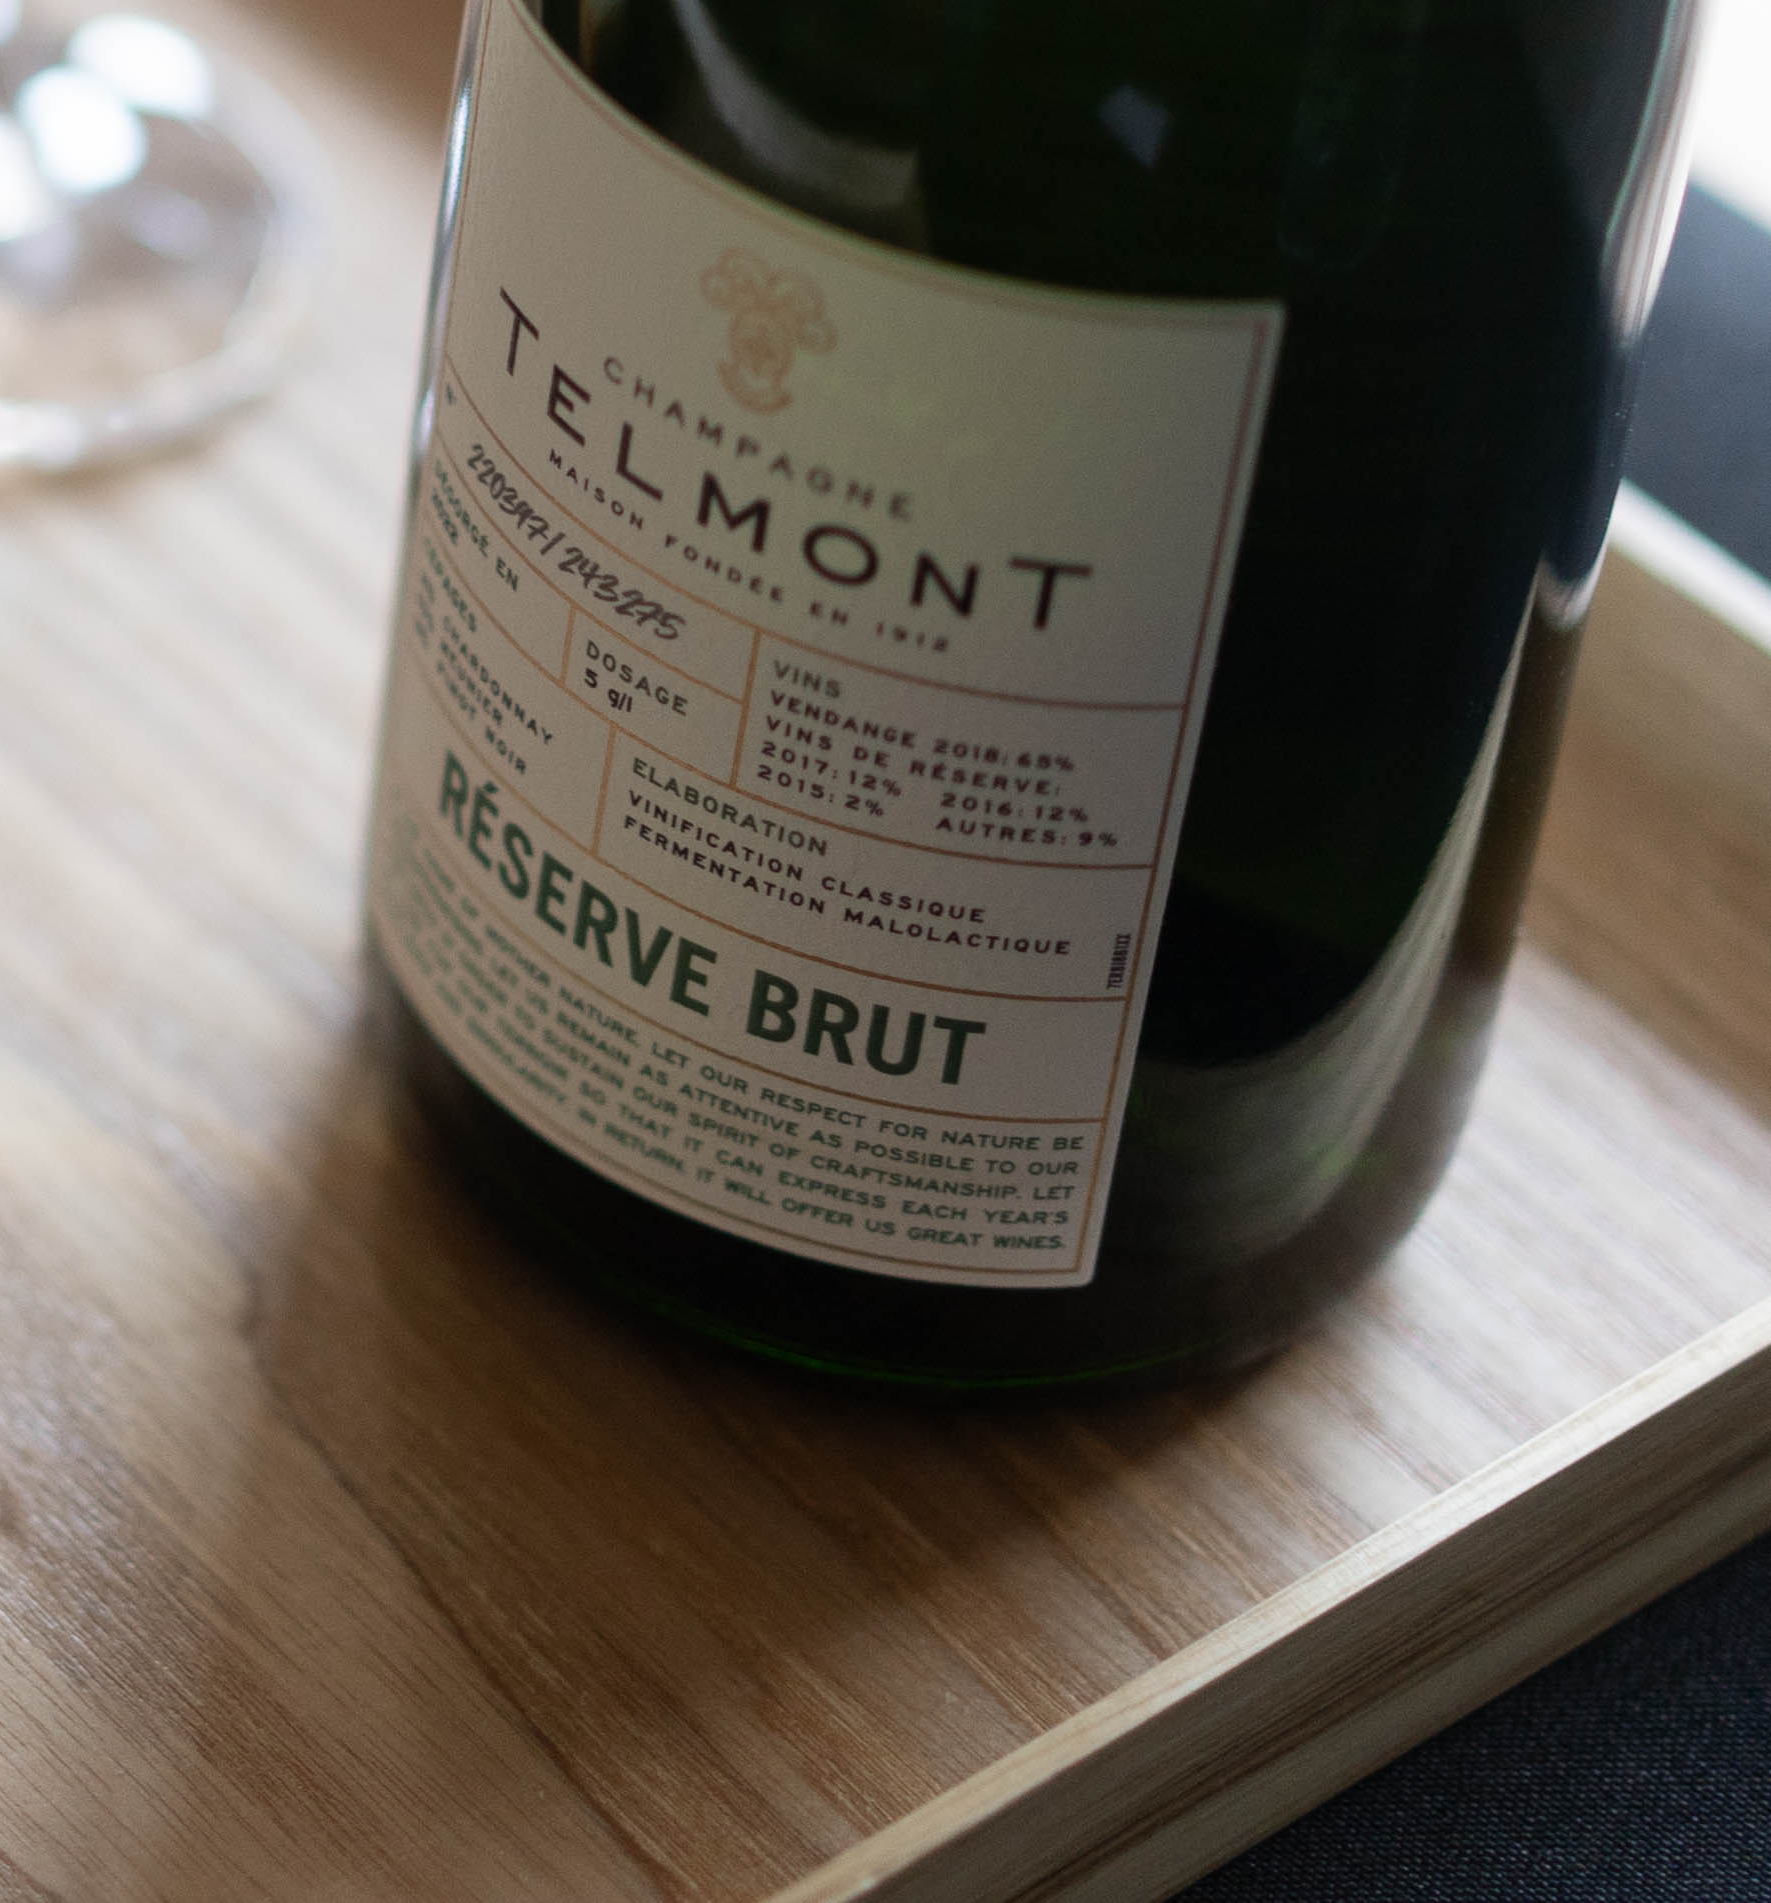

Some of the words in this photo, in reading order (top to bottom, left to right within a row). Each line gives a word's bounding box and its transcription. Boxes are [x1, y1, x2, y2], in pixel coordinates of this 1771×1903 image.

[499, 286, 1093, 631] TELMONT
[603, 355, 911, 521] CHAMPAGNE
[496, 556, 520, 592] EN
[548, 449, 645, 530] MAISON
[808, 599, 849, 626] EN
[583, 667, 599, 689] 5
[607, 688, 633, 713] g/l
[585, 639, 689, 717] DOSAGE
[770, 690, 917, 748] VENDANGE
[772, 659, 843, 699] VINS
[485, 726, 527, 775] NOIR
[765, 714, 833, 750] VINS
[852, 744, 891, 768] DE
[631, 756, 828, 857] ELABORATION
[844, 794, 884, 818] 2%
[936, 817, 1068, 846] AUTRES:
[848, 768, 902, 797] 12%
[1034, 805, 1089, 824] 12%
[623, 815, 826, 914] FERMENTATION
[843, 907, 1071, 956] MALOLACTIQUE
[628, 790, 804, 882] VINIFICATION
[820, 875, 986, 924] CLASSIQUE
[439, 748, 718, 1017] RÉSERVE
[746, 968, 987, 1085] BRUT
[557, 1010, 631, 1067] REMAIN
[639, 1063, 670, 1087] AS
[679, 1082, 800, 1137] ATTENTIVE
[809, 1129, 843, 1148] AS
[853, 1139, 975, 1172] POSSIBLE
[984, 1158, 1017, 1175] TO
[1027, 1160, 1081, 1177] OUR
[631, 1085, 680, 1117] OUR
[686, 1111, 761, 1148] SPIRIT
[768, 1141, 802, 1162] OF
[1031, 1184, 1076, 1202] LET
[651, 1042, 692, 1068] LET
[699, 1064, 749, 1094] OUR
[760, 1086, 867, 1128] RESPECT
[878, 1118, 929, 1142] FOR
[940, 1129, 1040, 1152] NATURE
[1051, 1136, 1085, 1151] BE
[618, 1101, 673, 1139] THAT
[682, 1134, 707, 1153] IT
[715, 1148, 764, 1176] CAN
[777, 1169, 887, 1209] EXPRESS
[901, 1199, 968, 1221] EACH
[983, 1209, 1070, 1226] YEAR'S
[695, 1166, 717, 1184] IT
[723, 1178, 773, 1206] WILL
[780, 1197, 855, 1229] OFFER
[864, 1218, 897, 1237] US
[906, 1225, 984, 1247] GREAT
